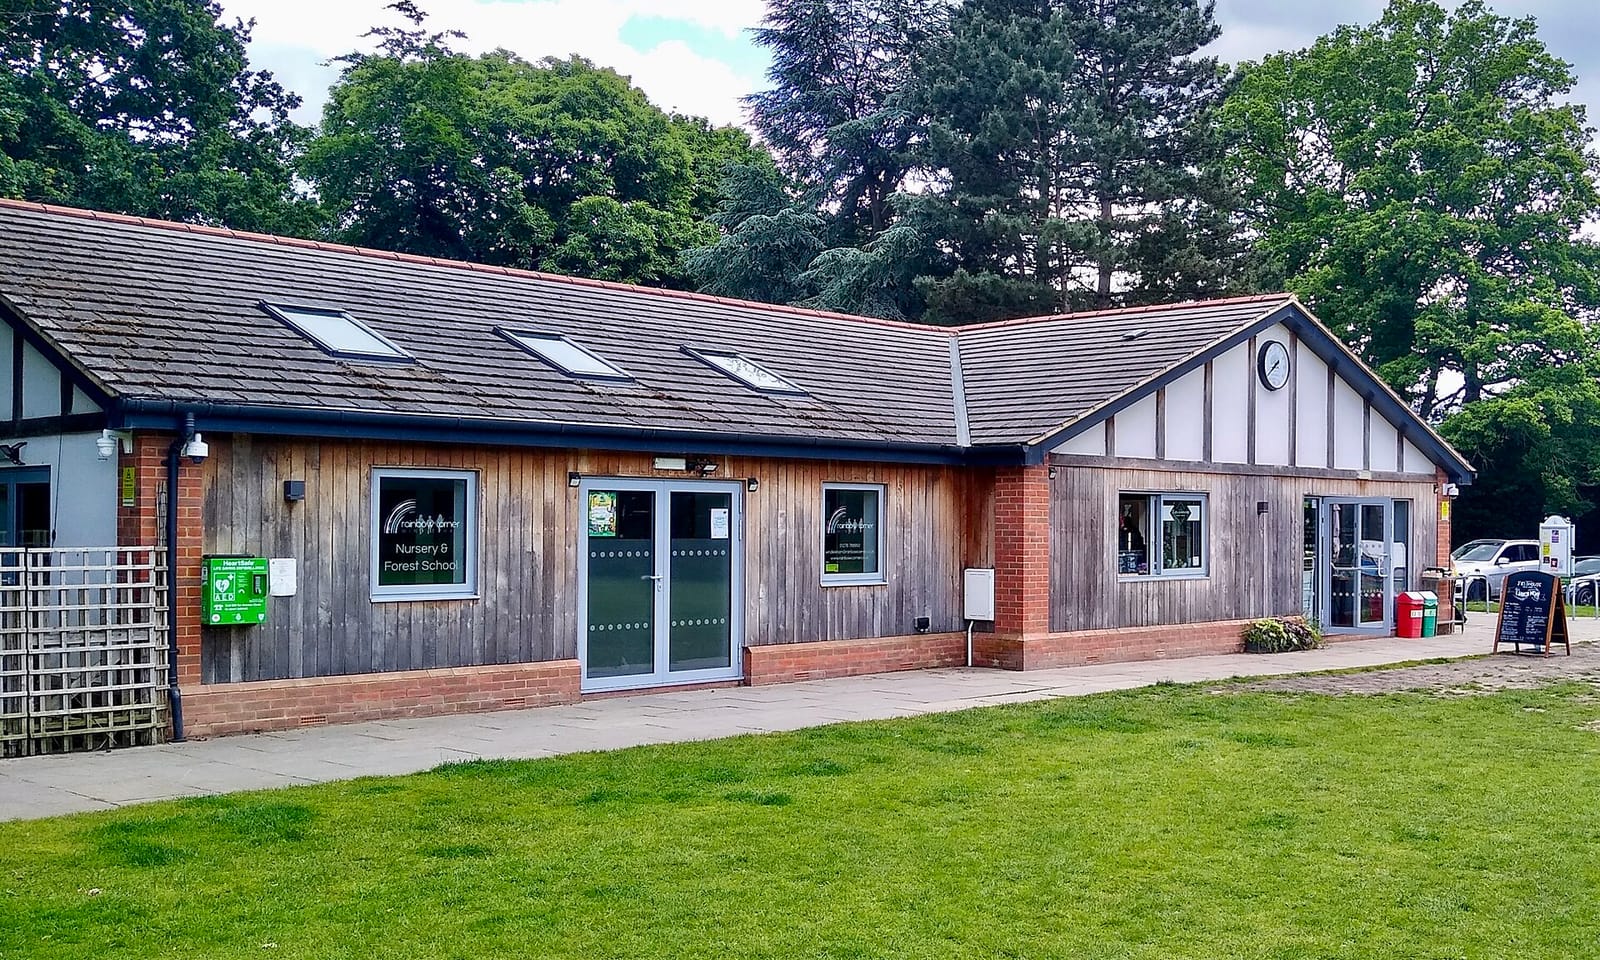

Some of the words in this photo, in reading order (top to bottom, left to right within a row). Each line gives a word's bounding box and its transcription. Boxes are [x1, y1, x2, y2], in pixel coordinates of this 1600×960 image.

[395, 543, 439, 556] Nursery
[440, 542, 448, 553] &
[384, 560, 419, 571] Forest
[421, 560, 458, 571] School
